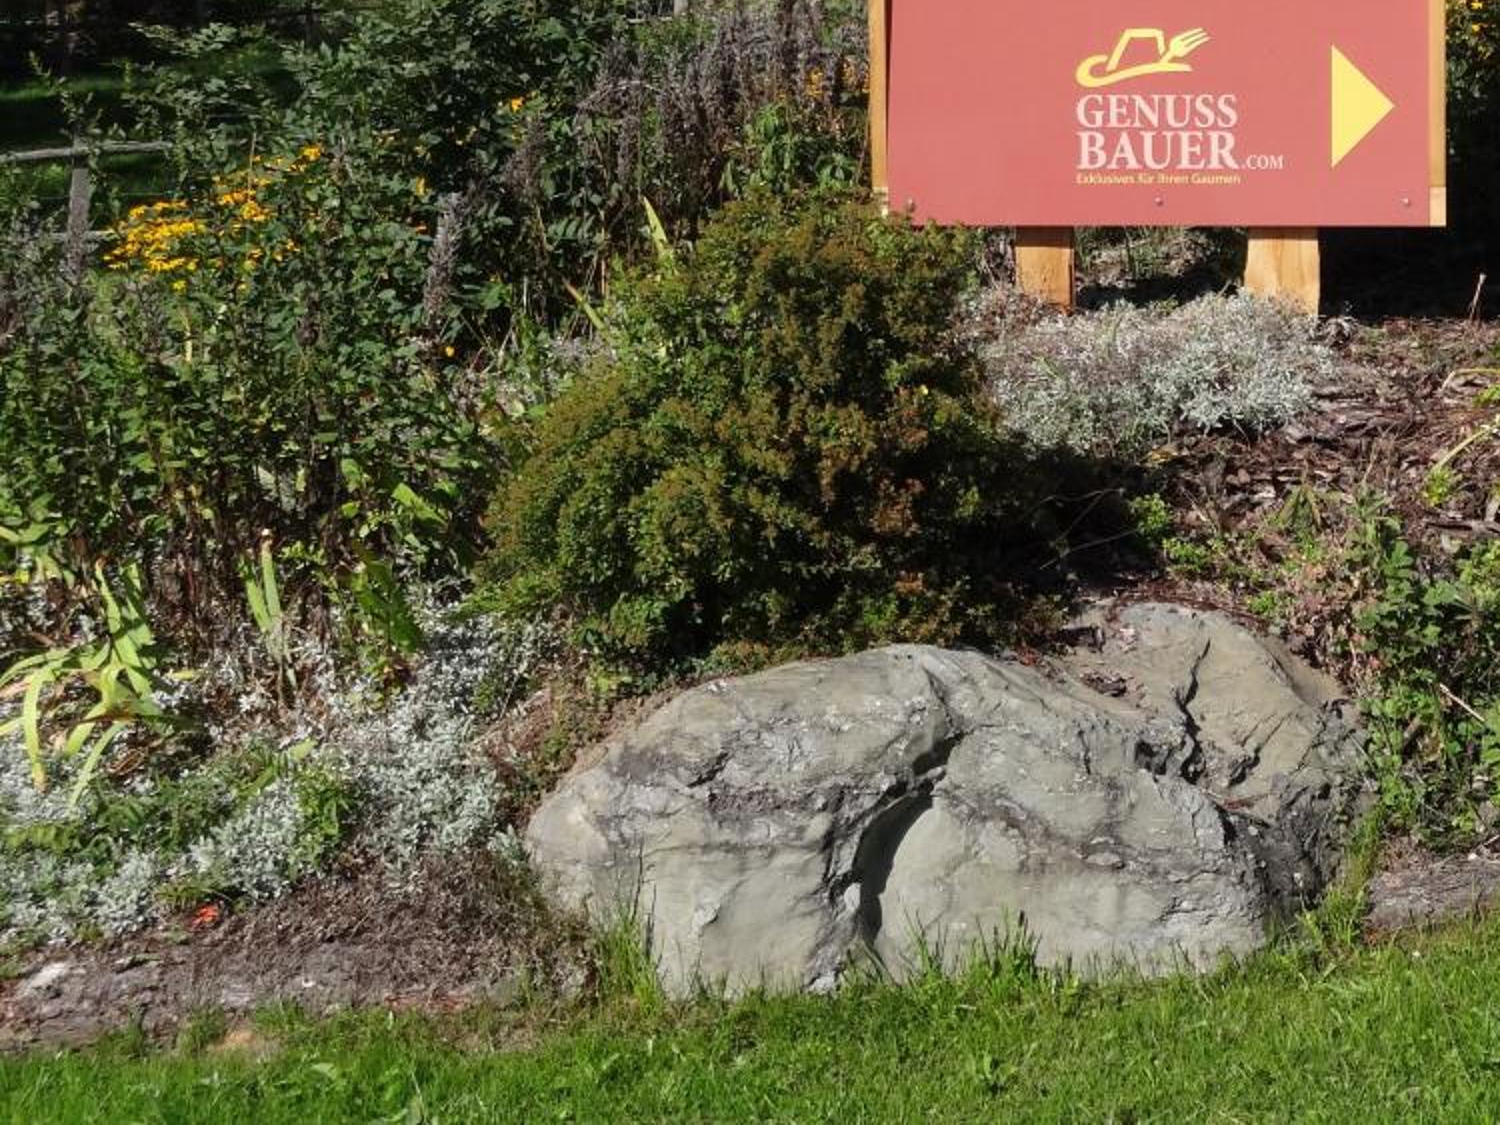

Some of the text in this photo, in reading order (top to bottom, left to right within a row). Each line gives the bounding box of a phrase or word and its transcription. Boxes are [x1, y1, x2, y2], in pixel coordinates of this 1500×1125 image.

[1076, 94, 1239, 129] GENUSS
[1137, 174, 1154, 184] für
[1158, 173, 1188, 184] Ihren
[1191, 173, 1241, 184] Gaumen
